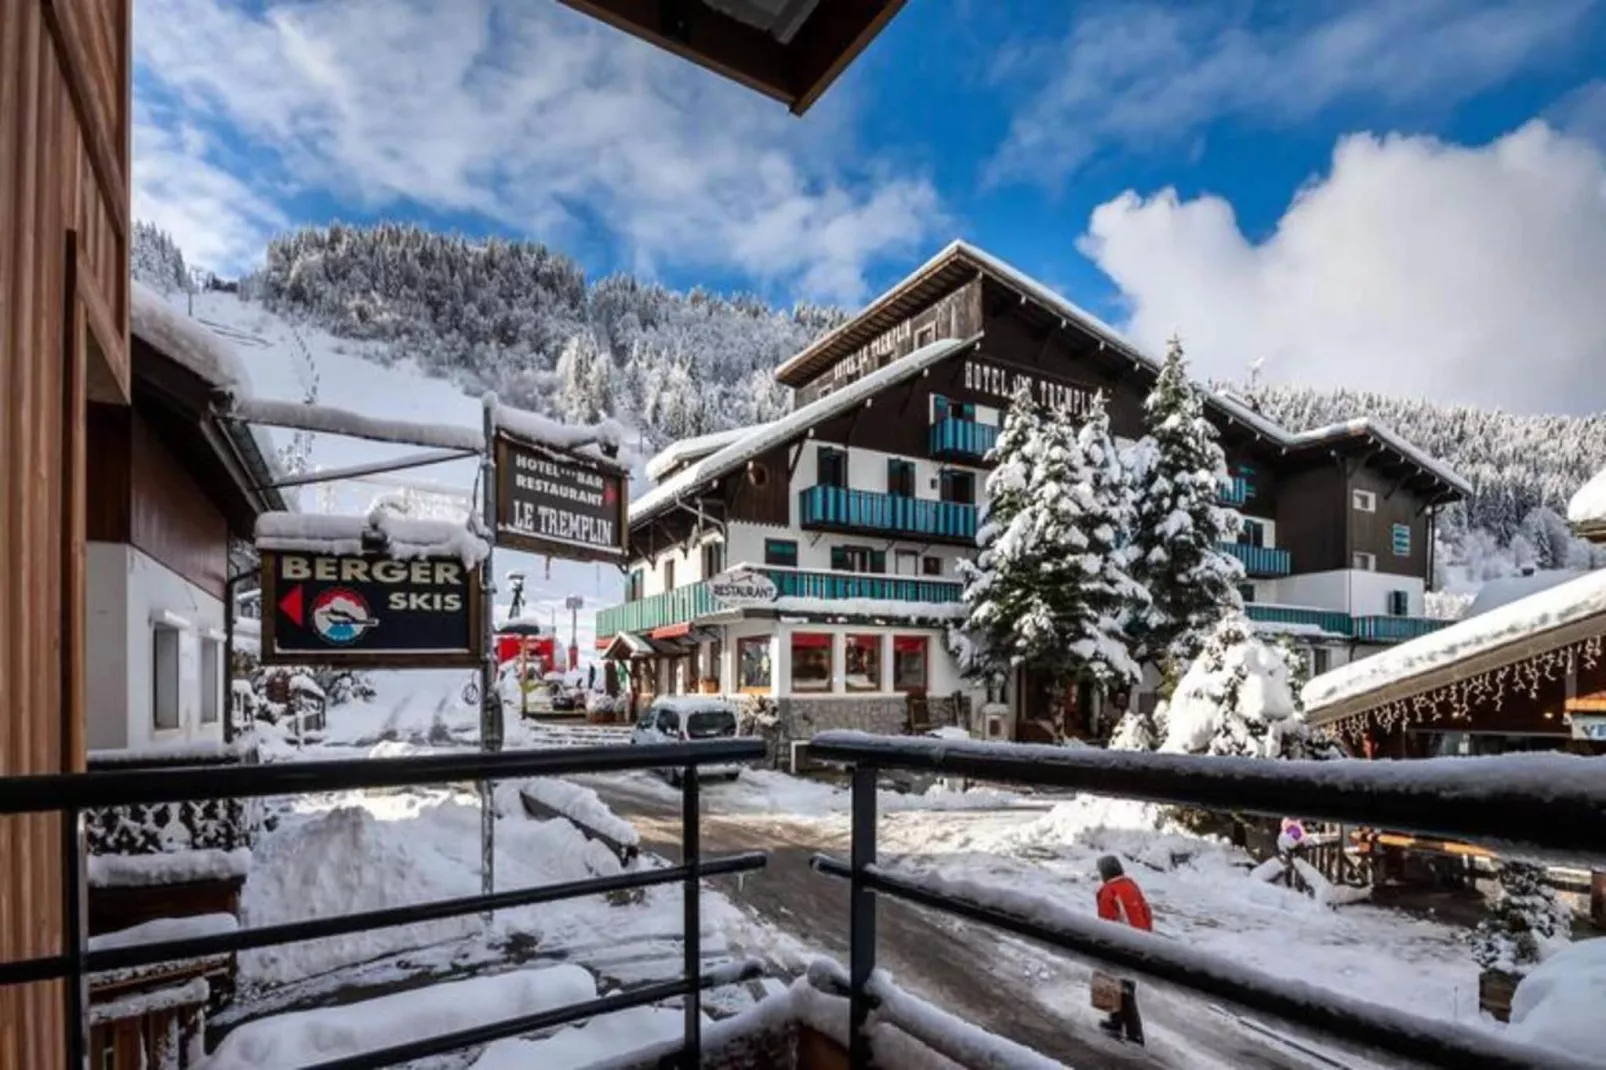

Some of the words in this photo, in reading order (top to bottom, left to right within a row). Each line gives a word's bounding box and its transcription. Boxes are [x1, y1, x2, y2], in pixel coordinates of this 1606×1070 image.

[965, 361, 1009, 398] HOTEL
[1040, 380, 1103, 421] TREMPL
[516, 454, 560, 478] HOTEL
[576, 471, 604, 489] BAR
[515, 473, 604, 507] RESTAURANT
[513, 500, 534, 532] LE
[537, 505, 612, 545] TREMPLIN
[281, 556, 462, 585] BERGER
[388, 592, 462, 612] SKIS
[714, 584, 774, 599] RESTAURANT
